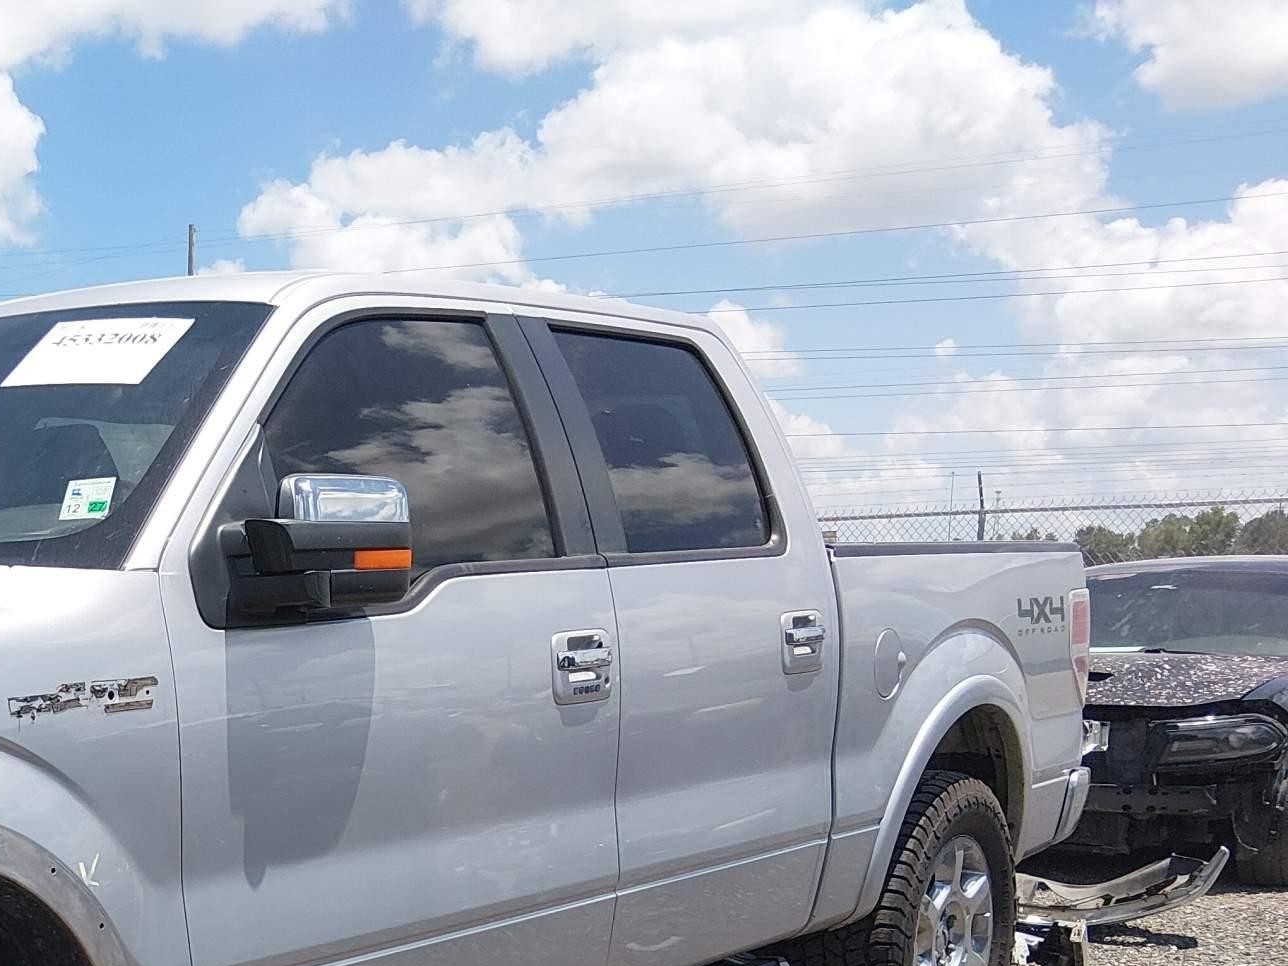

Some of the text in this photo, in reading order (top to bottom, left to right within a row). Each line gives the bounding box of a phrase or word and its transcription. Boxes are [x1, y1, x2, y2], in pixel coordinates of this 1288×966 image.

[52, 332, 162, 346] 45332008
[66, 501, 107, 514] 12 27
